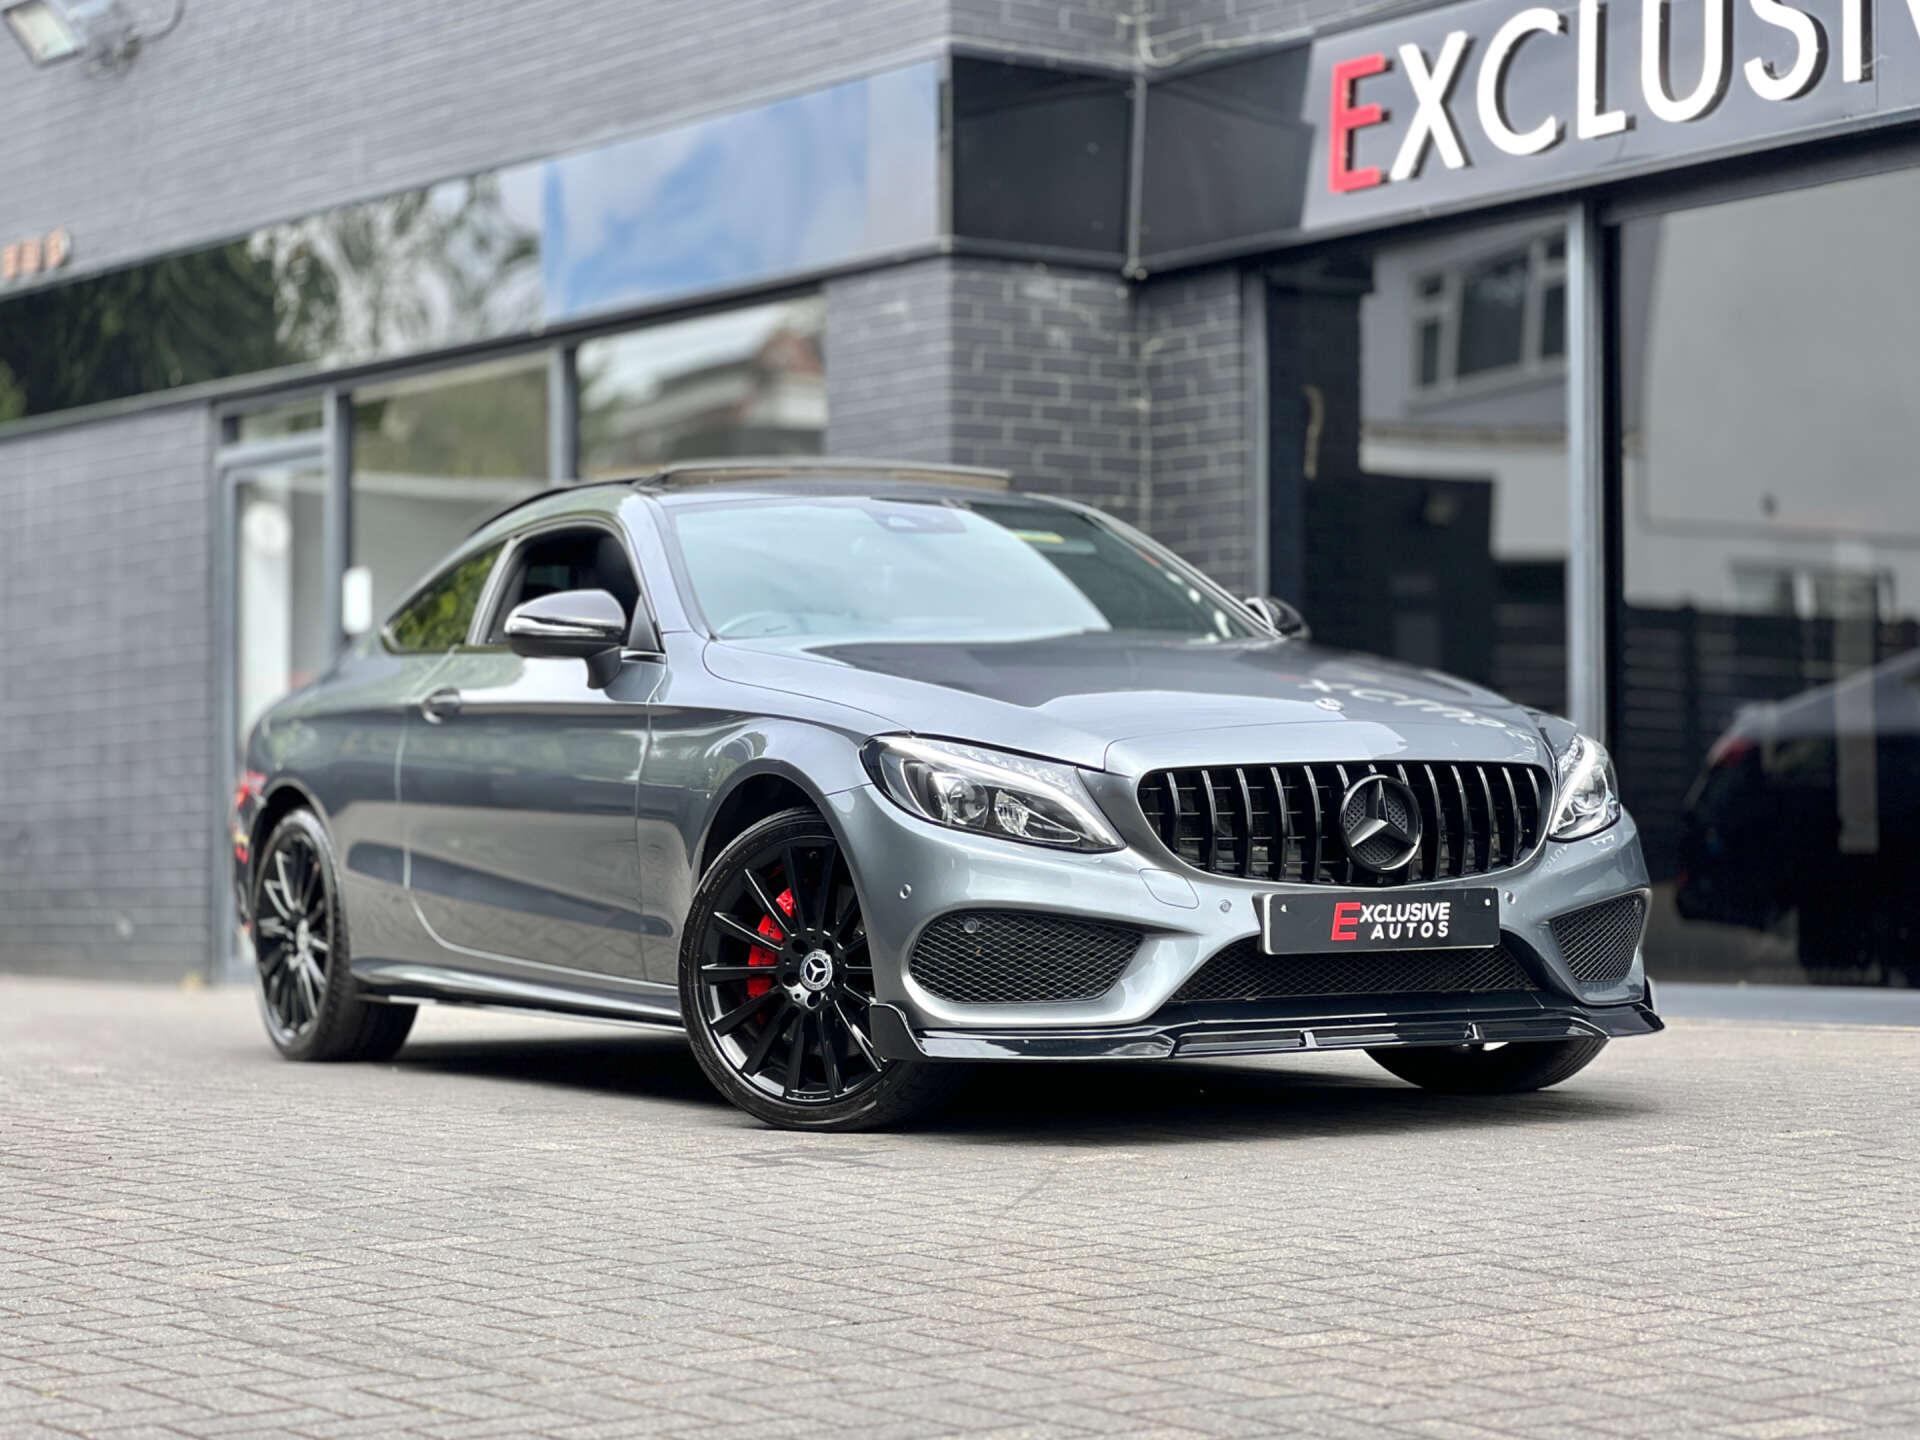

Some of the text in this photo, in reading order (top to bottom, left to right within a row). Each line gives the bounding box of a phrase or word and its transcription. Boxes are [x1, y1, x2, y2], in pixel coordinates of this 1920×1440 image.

[1329, 0, 1920, 193] EXCLUSI
[1331, 902, 1451, 941] EXCLUSIVE
[1370, 921, 1449, 940] AUTOS
